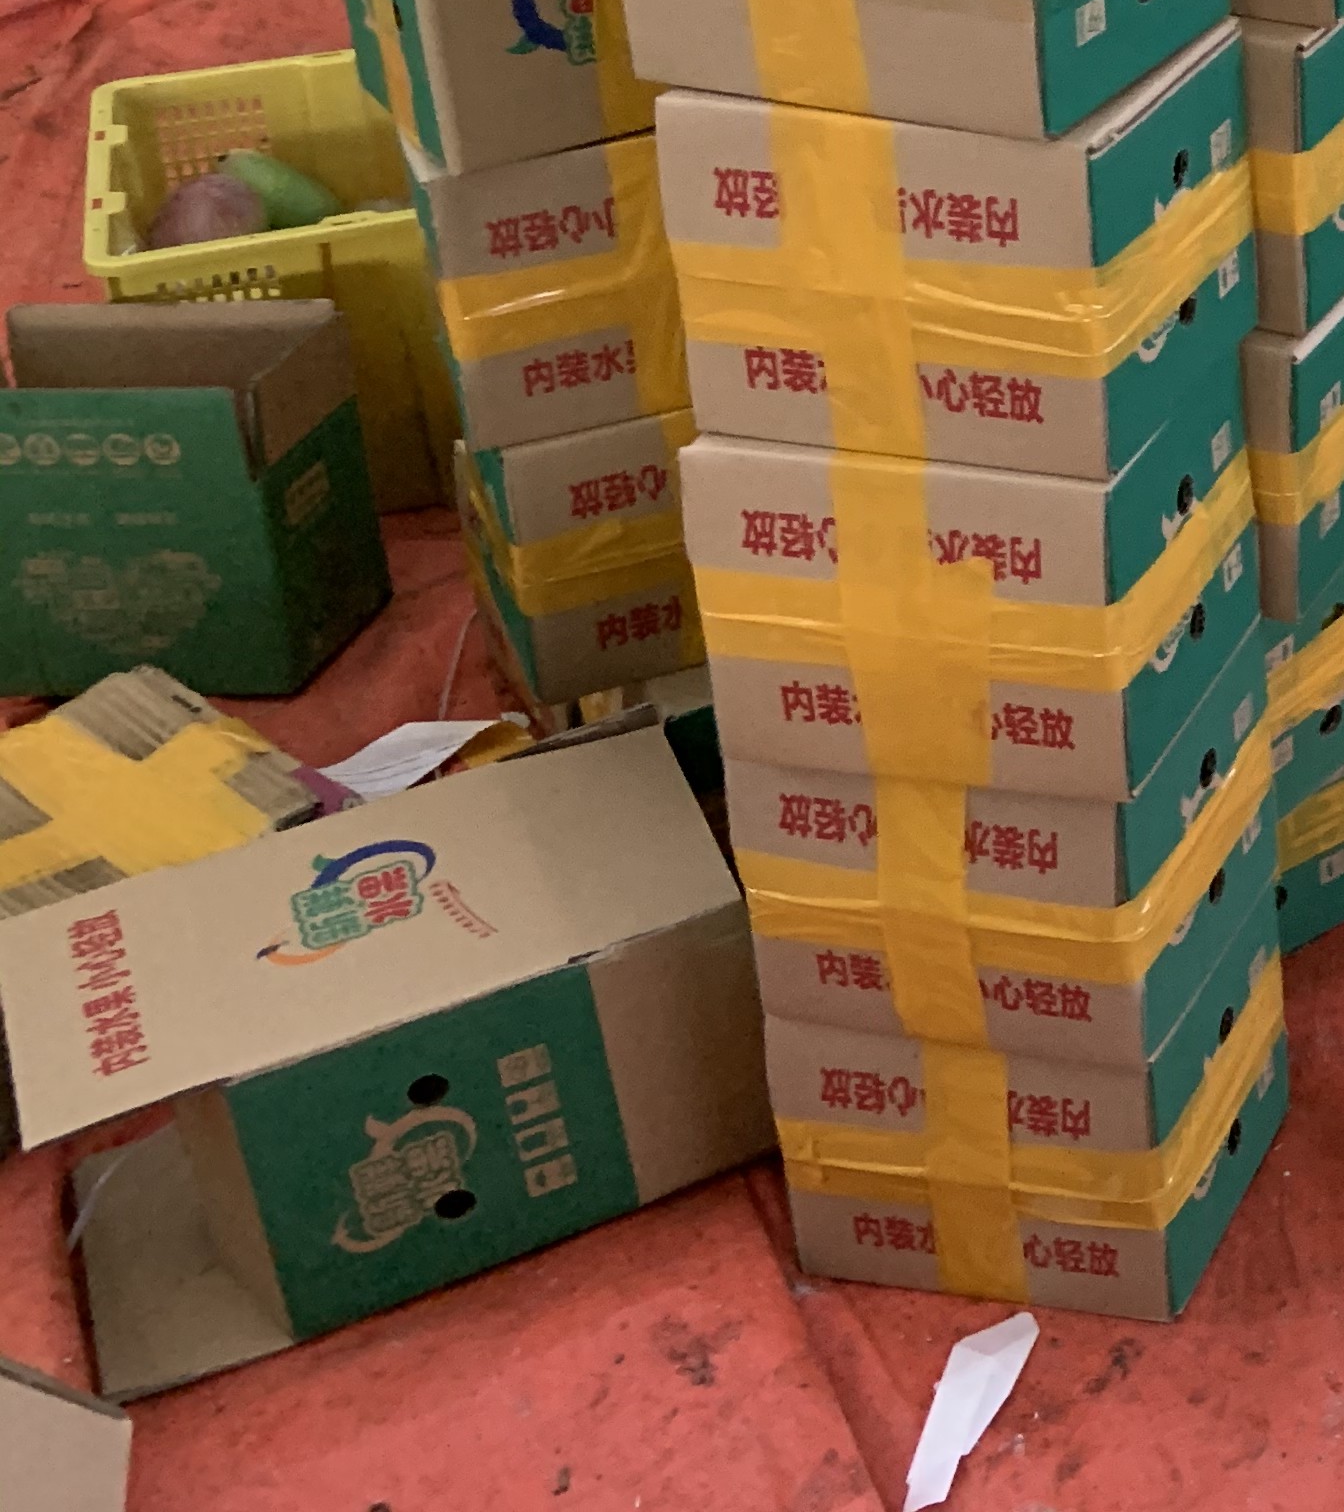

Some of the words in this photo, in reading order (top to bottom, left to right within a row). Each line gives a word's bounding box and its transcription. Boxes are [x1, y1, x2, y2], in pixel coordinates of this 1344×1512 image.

[744, 346, 828, 394] 内装
[920, 369, 1046, 426] 心轻放
[569, 464, 669, 519] 心轻放
[928, 527, 1044, 585] 内装水
[779, 680, 861, 727] 内装
[990, 700, 1076, 752] 轻放
[776, 792, 878, 849] 心轻放
[964, 817, 1059, 877] 内装水
[813, 949, 890, 994] 内装
[979, 972, 1095, 1025] 心轻放
[817, 1066, 926, 1119] 心轻放
[1022, 1232, 1122, 1280] 心轻放
